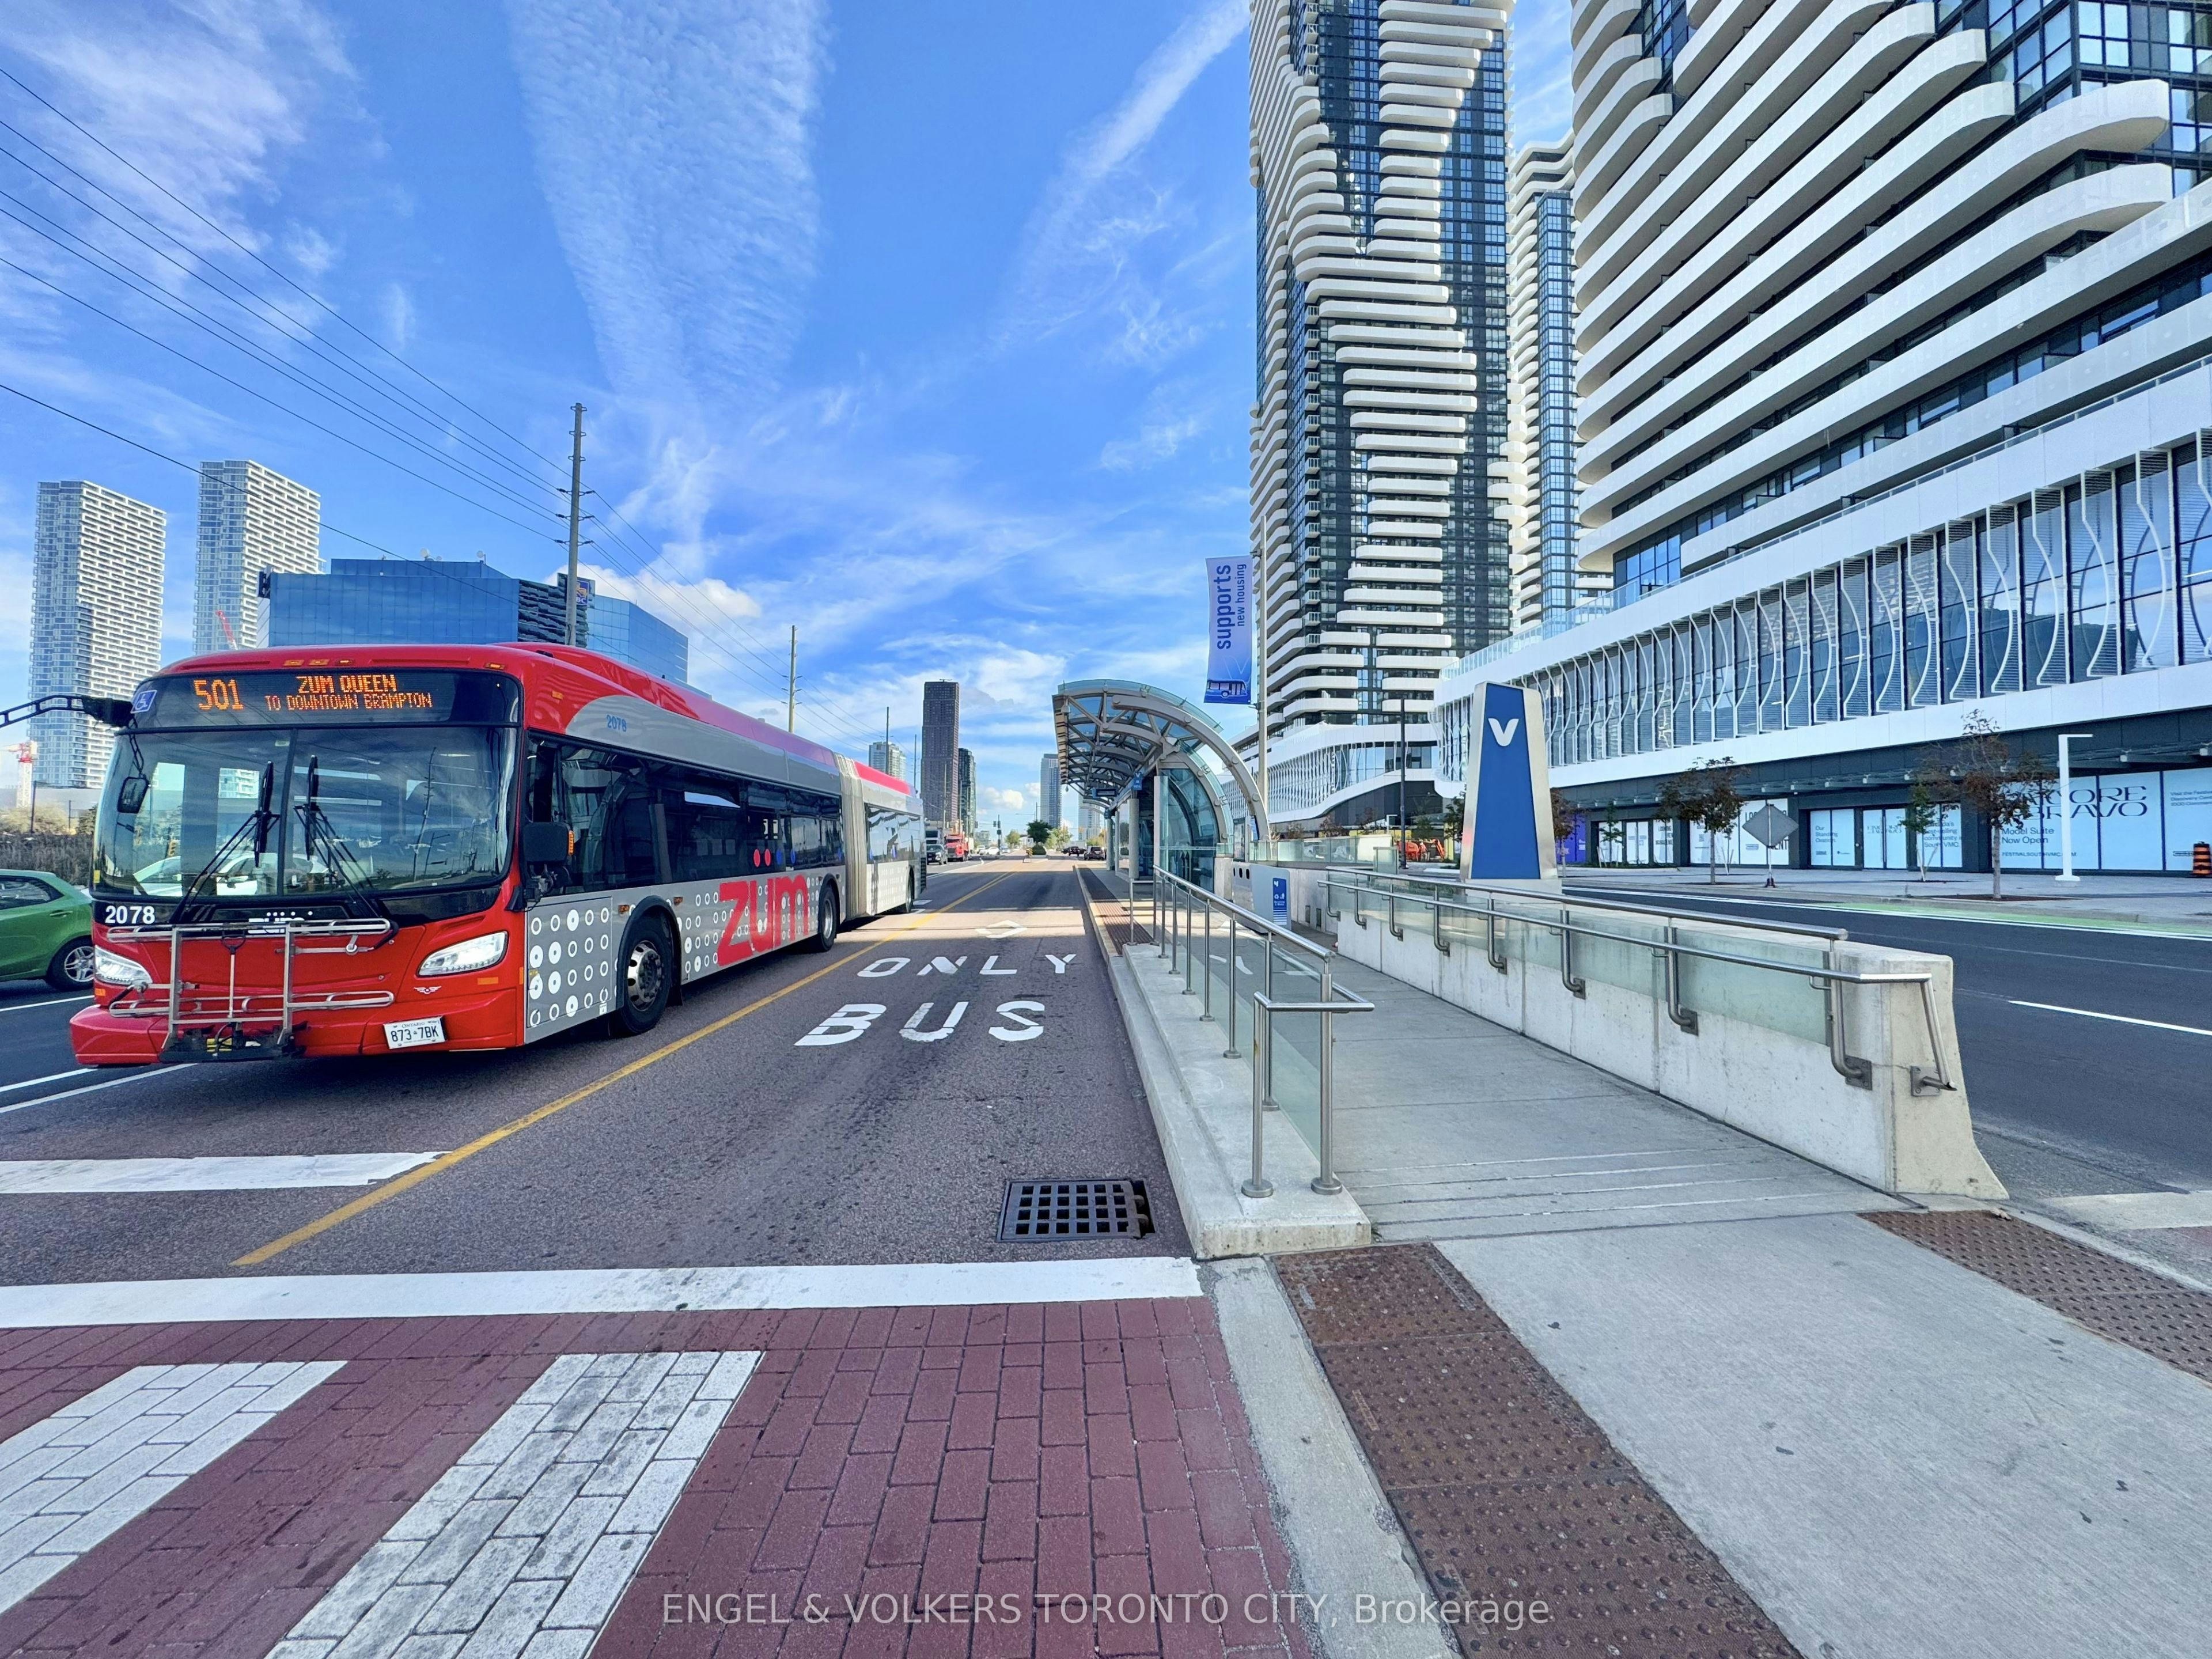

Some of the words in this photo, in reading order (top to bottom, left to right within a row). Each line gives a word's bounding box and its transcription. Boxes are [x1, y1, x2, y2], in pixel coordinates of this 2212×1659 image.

[1234, 564, 1247, 604] housing
[1213, 565, 1236, 650] supports
[1237, 606, 1245, 627] new
[193, 679, 244, 711] 501
[295, 675, 334, 694] ZUM
[339, 674, 397, 693] QUEEN
[264, 695, 282, 711] TO
[286, 694, 358, 711] DOWNTOWN
[363, 692, 433, 710] BRAMPTON
[606, 714, 627, 732] 2078
[104, 905, 156, 924] 2078
[857, 953, 1077, 978] ONLY
[793, 1000, 1046, 1047] BUS
